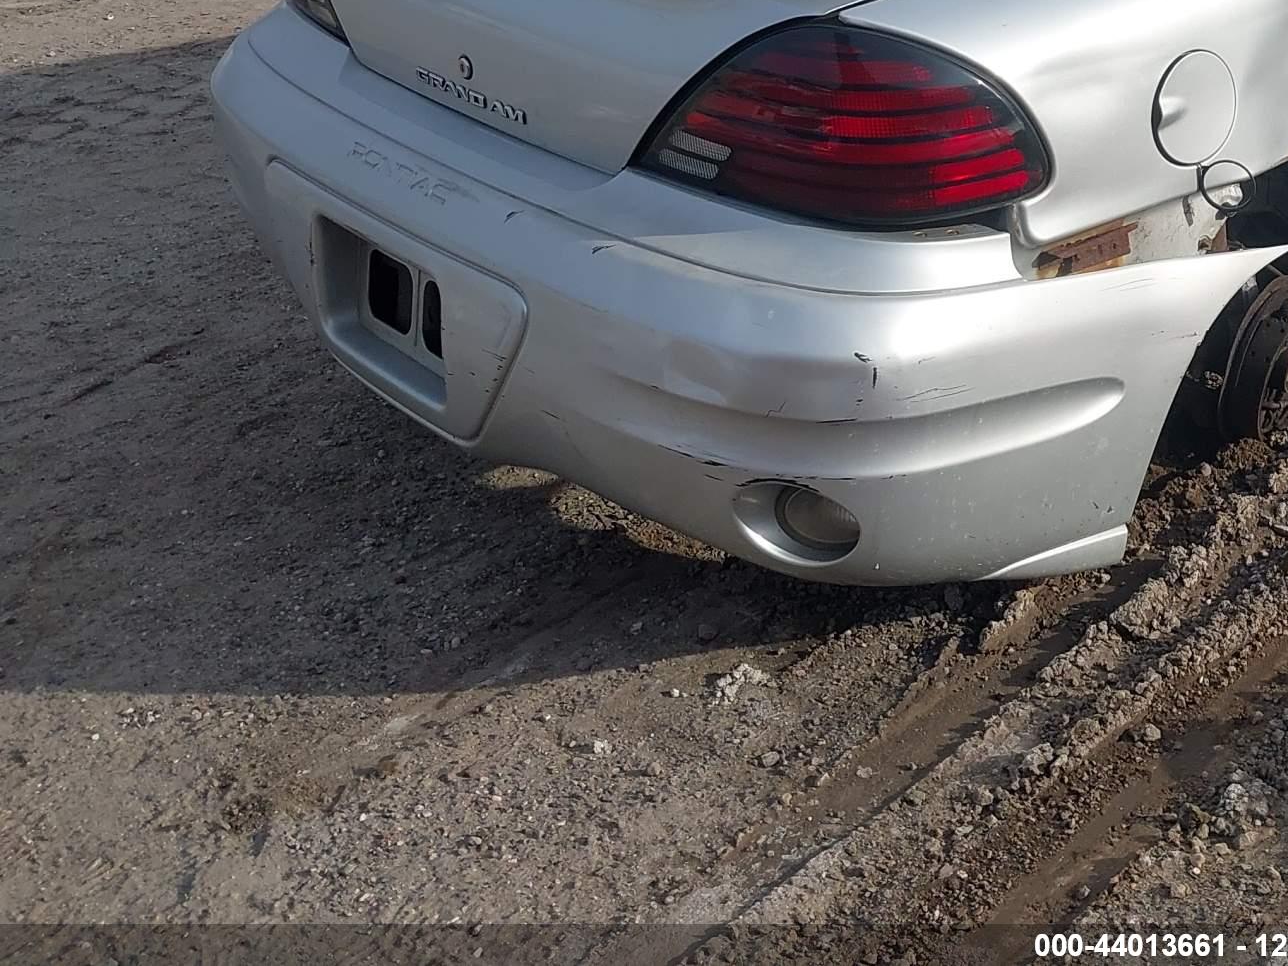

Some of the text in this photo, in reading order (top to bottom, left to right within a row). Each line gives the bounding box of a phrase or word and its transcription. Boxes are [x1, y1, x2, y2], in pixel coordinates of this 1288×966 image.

[416, 66, 527, 125] GRAND AM
[347, 140, 454, 205] PONTIAC
